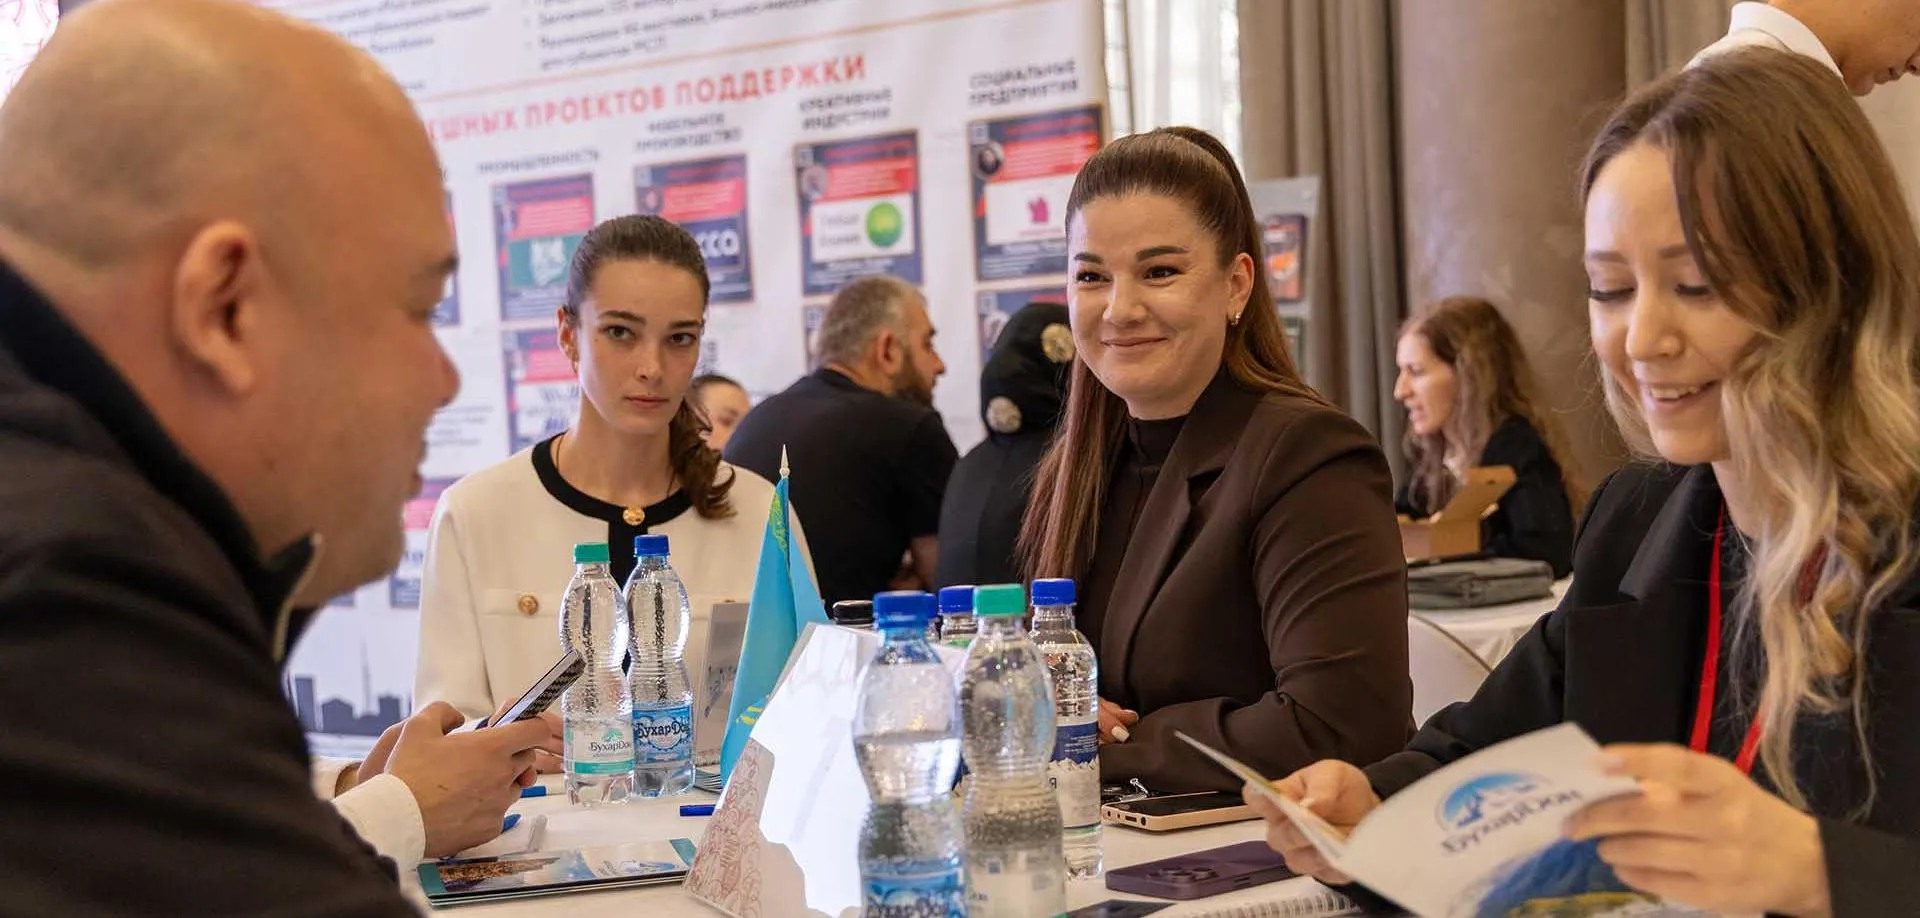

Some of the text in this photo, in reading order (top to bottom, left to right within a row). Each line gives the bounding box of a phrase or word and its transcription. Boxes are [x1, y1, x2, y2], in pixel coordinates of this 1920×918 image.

[969, 60, 1077, 89] СОЦИАЛЬНЫЕ
[524, 84, 667, 129] ПРОЕКТОВ
[674, 52, 866, 104] ПОДДЕРЖКИ
[968, 78, 1079, 107] ПРЕДПРИЯТИЯ
